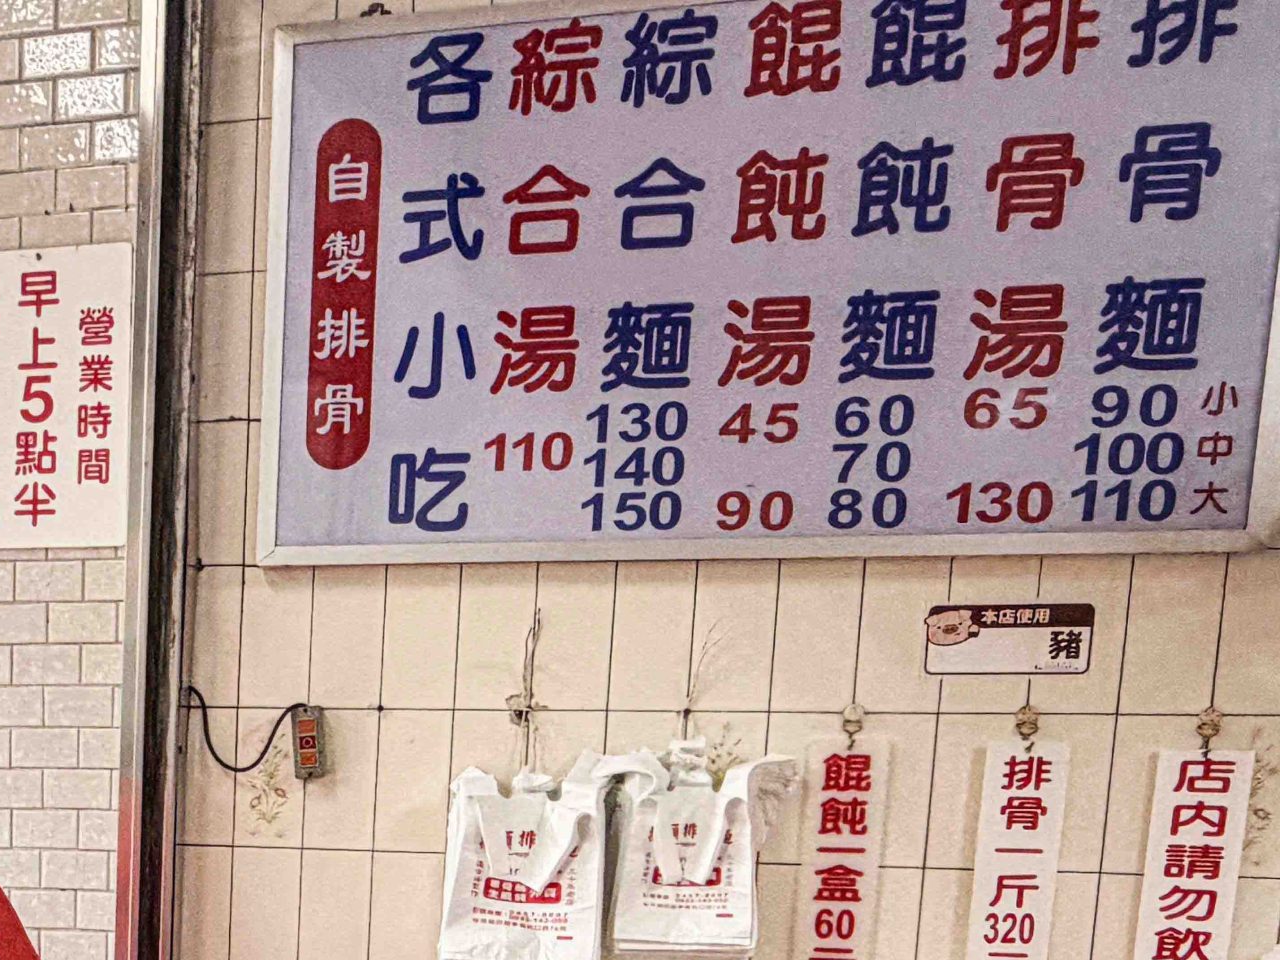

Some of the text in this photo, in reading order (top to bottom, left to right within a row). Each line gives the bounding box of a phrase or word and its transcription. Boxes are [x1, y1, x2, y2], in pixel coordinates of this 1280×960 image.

[492, 21, 602, 394] 綜合湯
[601, 9, 717, 392] 綜合麵
[721, 0, 840, 385] 餛飩湯
[840, 0, 967, 383] 餛飩麵
[966, 0, 1097, 379] 排骨湯
[1094, 0, 1236, 374] 排骨麵
[313, 153, 371, 434] 自製排骨
[389, 32, 493, 532] 各式小吃
[14, 271, 60, 527] 早上5點半
[77, 306, 114, 484] 營業時間
[835, 395, 914, 437] 60
[968, 390, 1047, 429] 65
[1092, 384, 1177, 428] 90
[587, 401, 688, 443] 130
[721, 404, 799, 444] 45
[484, 433, 572, 472] 110
[584, 447, 684, 487] 140
[832, 441, 911, 483] 70
[1075, 432, 1184, 475] 100
[582, 491, 681, 532] 150
[717, 491, 792, 531] 90
[828, 488, 906, 529] 80
[948, 482, 1052, 524] 130
[1072, 479, 1177, 521] 110
[980, 608, 1050, 625] 本店使用
[1048, 629, 1083, 660] 豬
